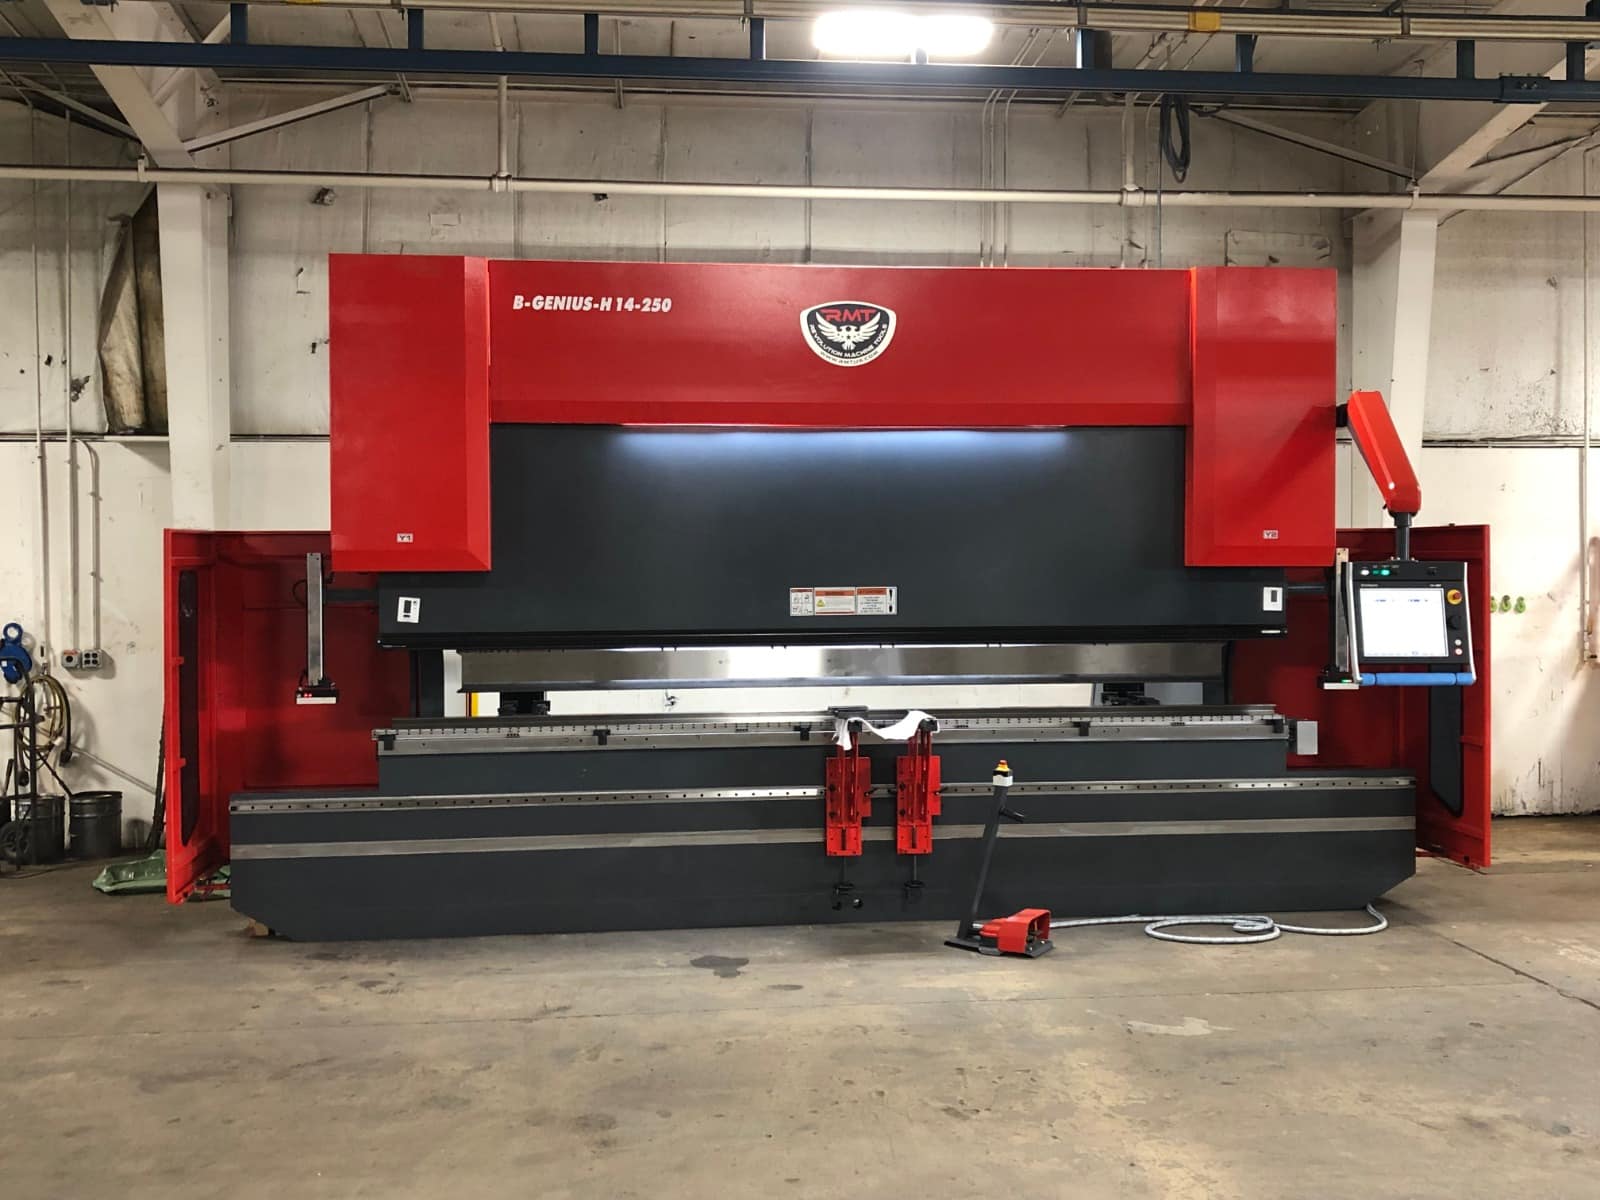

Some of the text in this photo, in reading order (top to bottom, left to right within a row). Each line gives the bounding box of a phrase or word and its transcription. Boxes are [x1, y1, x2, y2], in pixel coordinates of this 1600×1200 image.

[513, 295, 672, 312] B-GENIUS-H 14-250
[820, 309, 877, 322] RMT
[809, 324, 843, 357] REVOLUTION
[844, 345, 874, 358] MACHINE
